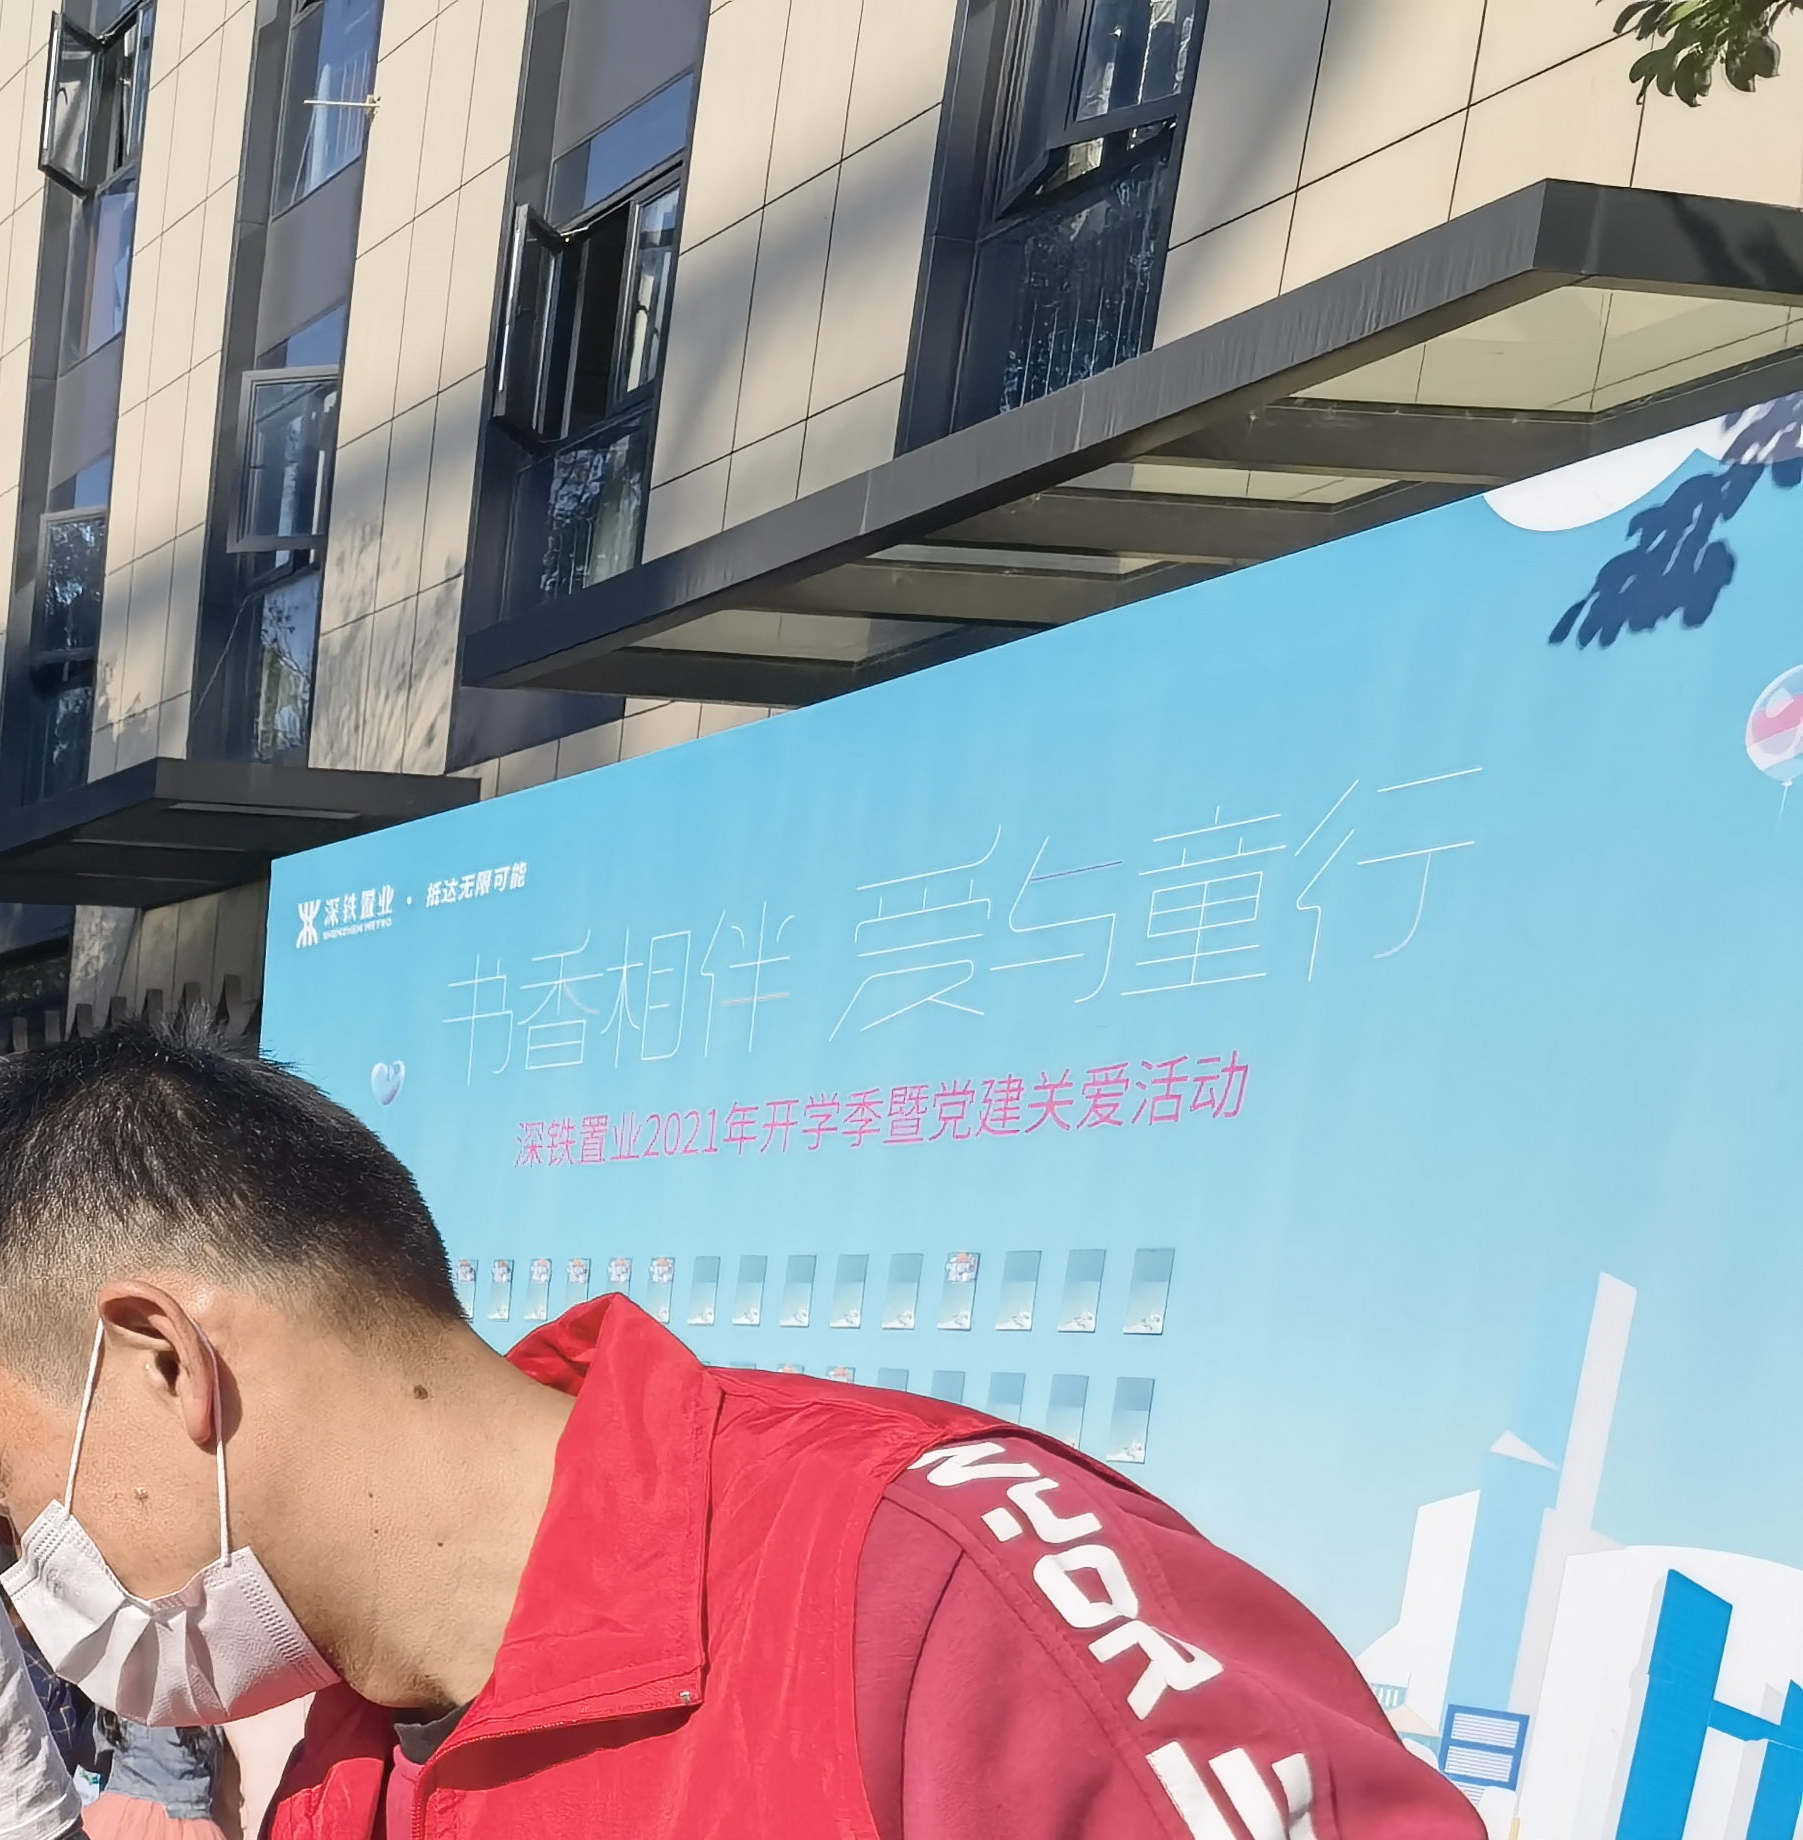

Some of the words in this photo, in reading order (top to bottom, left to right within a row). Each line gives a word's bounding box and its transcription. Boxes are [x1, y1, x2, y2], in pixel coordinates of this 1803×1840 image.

[323, 884, 395, 928] 深铁置业
[425, 860, 528, 909] 抵达无限可能
[442, 899, 796, 1089] 书香相伴
[828, 766, 1484, 1043] 爱与童行
[513, 1049, 1251, 1169] 深铁置业2021年开学季暨党建关爱活动
